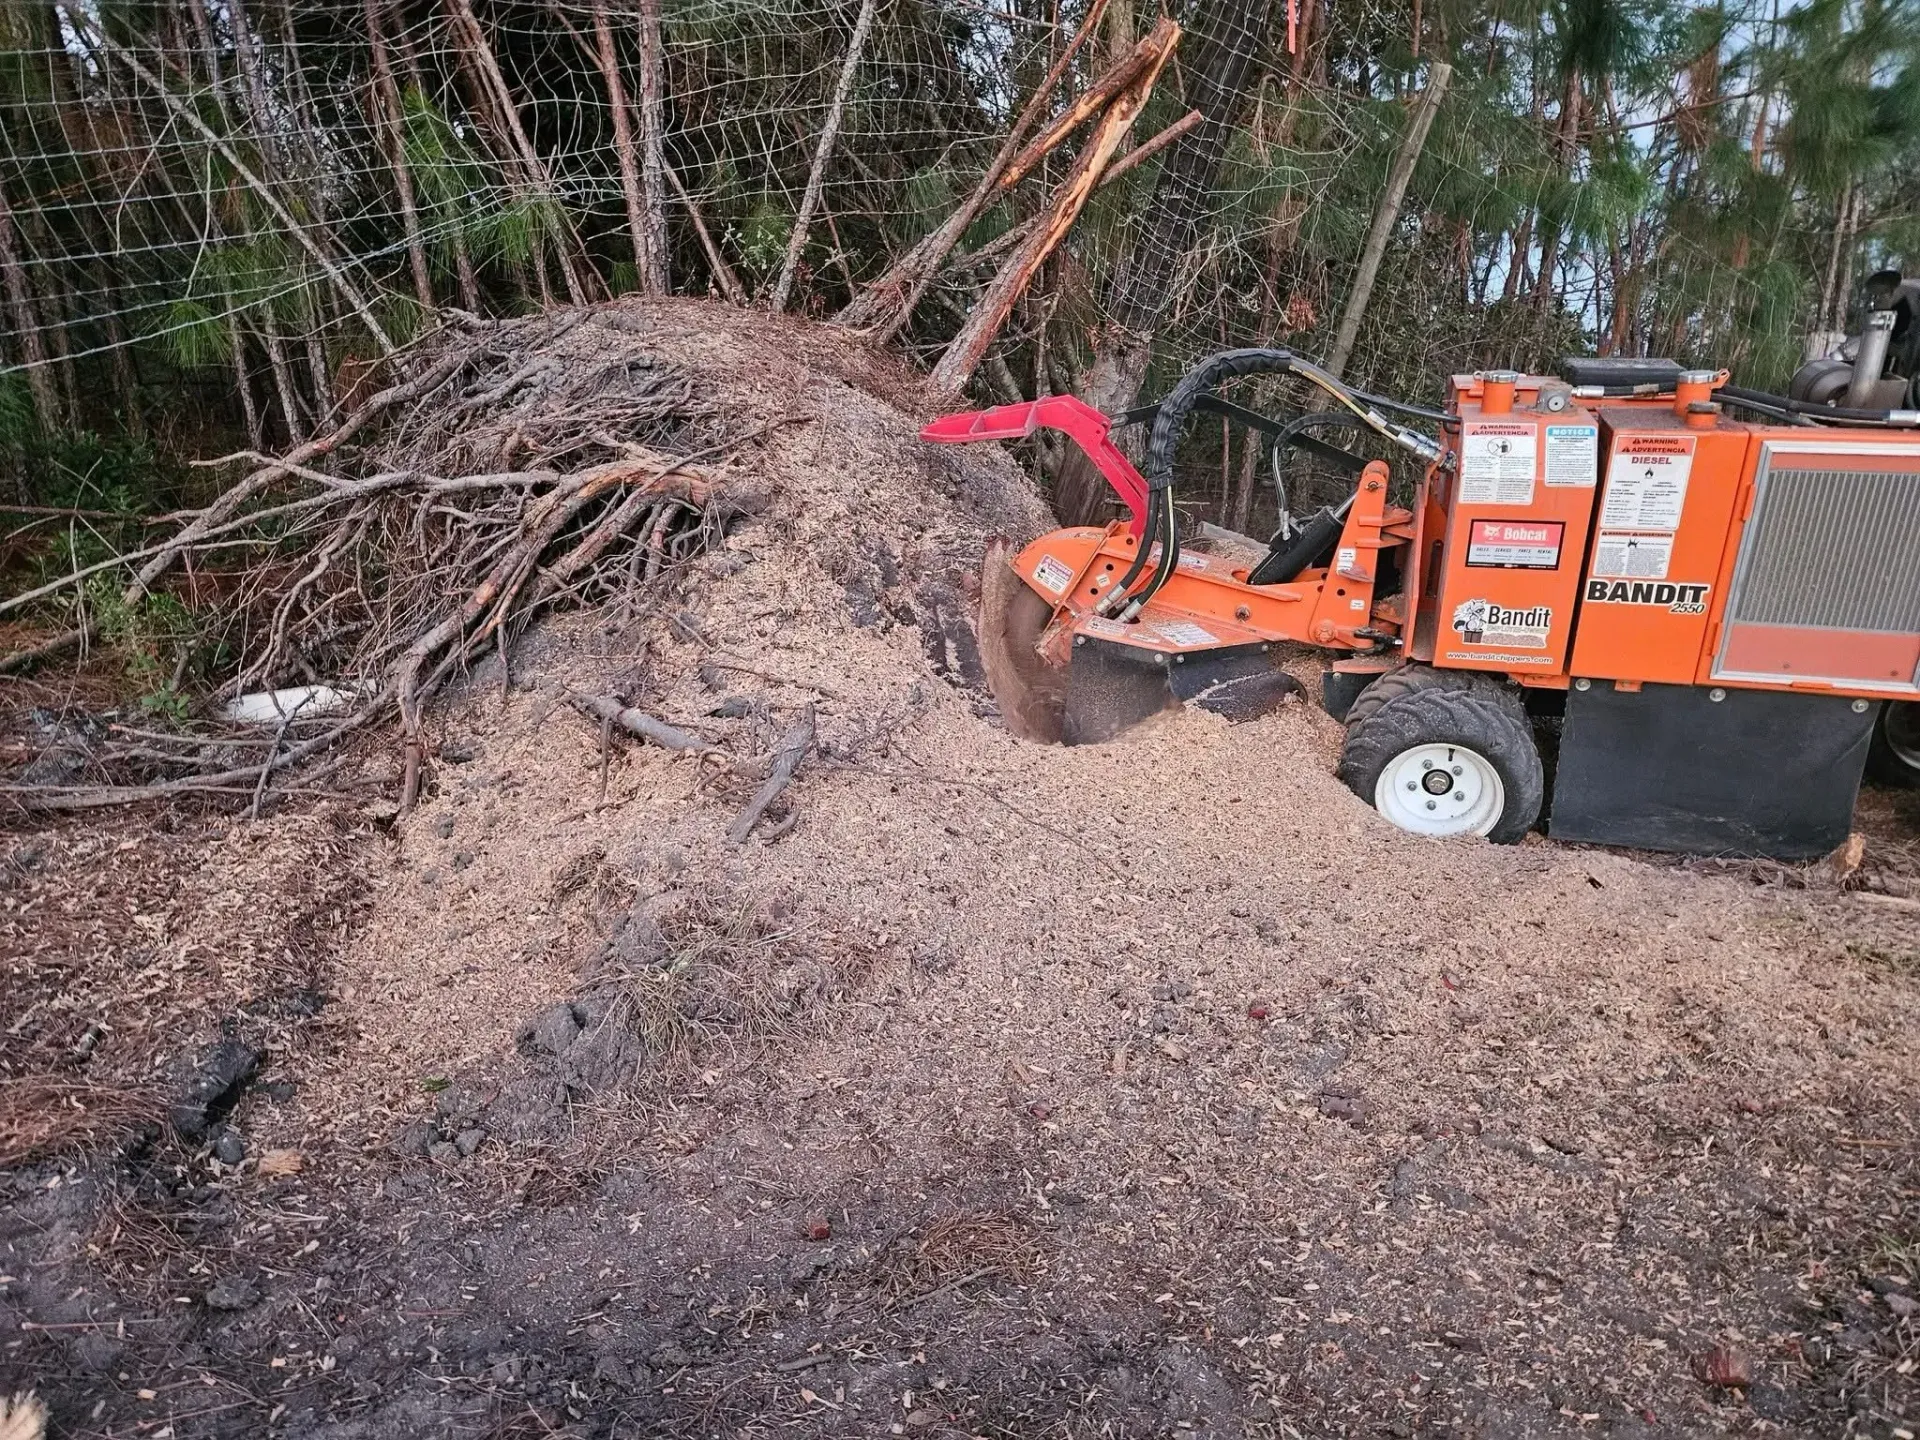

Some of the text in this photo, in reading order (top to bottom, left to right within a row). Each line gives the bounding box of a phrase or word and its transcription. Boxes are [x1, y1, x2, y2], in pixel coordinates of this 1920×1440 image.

[1552, 427, 1590, 436] NOTICE
[1631, 456, 1673, 465] DIESEL
[1503, 527, 1547, 541] Bobcat
[1587, 580, 1708, 604] BANDIT
[1670, 602, 1705, 614] 2550
[1488, 605, 1551, 628] Bandit
[1447, 652, 1552, 664] www.banditchippers.com
